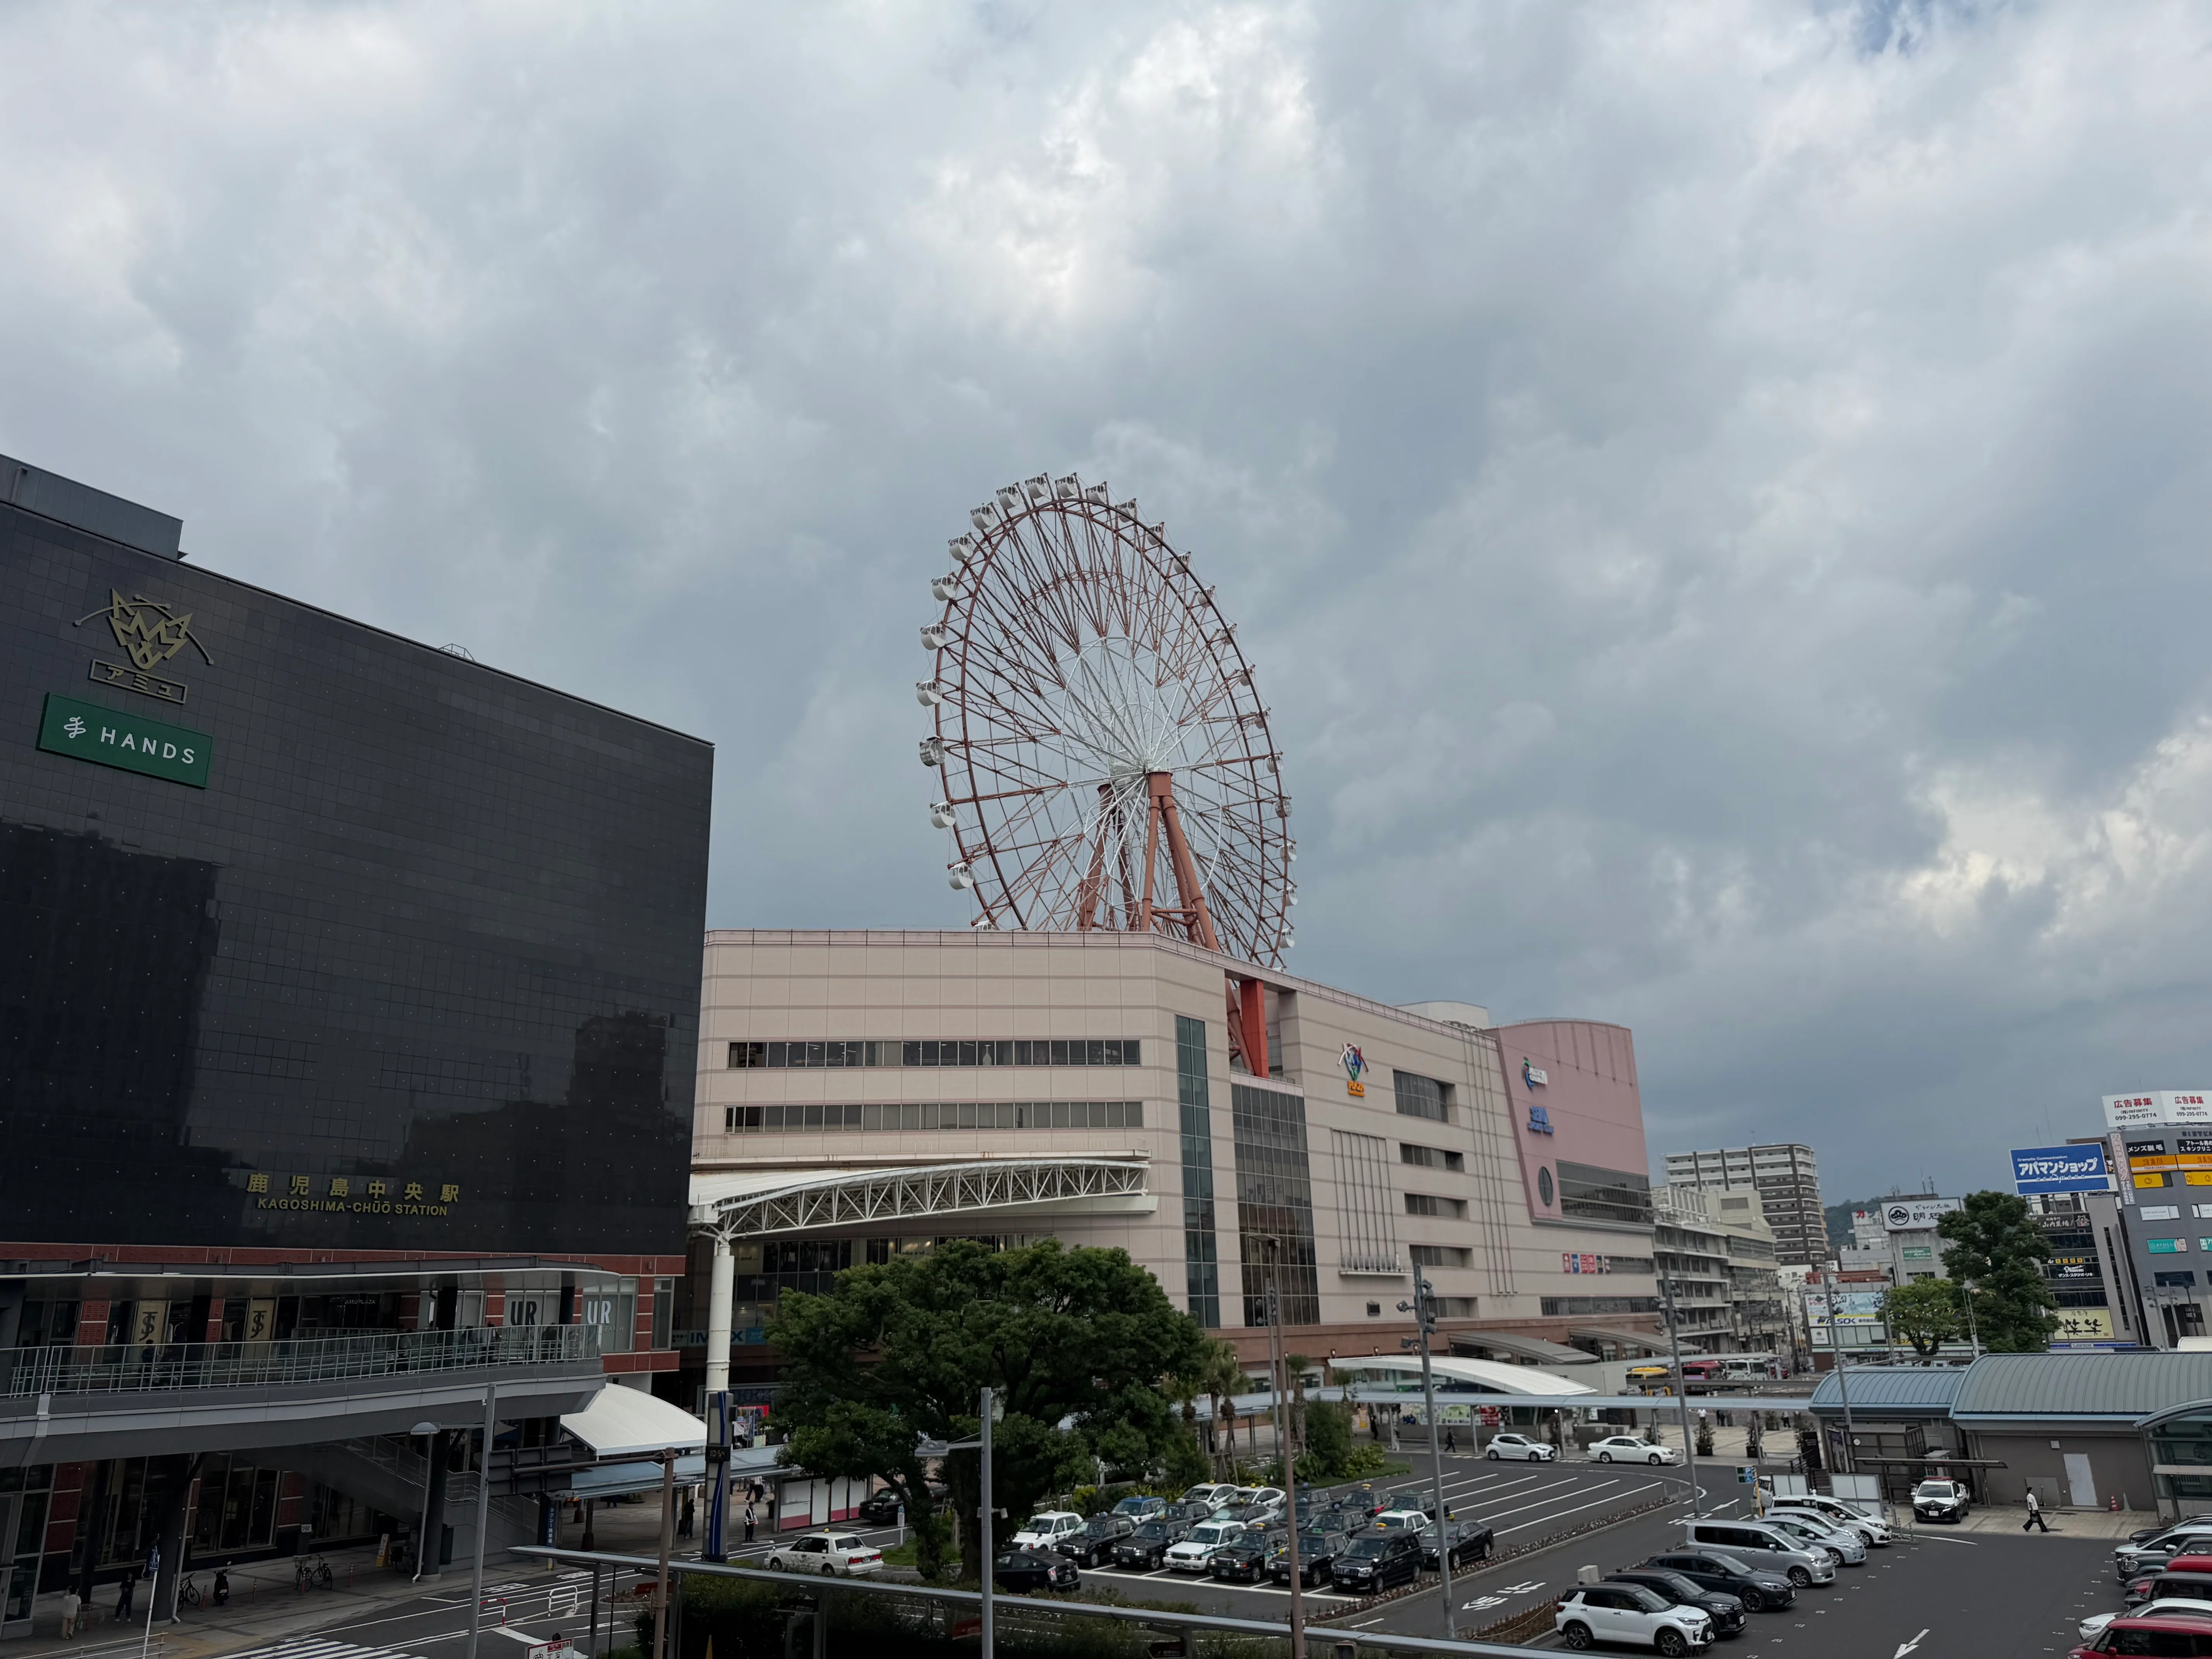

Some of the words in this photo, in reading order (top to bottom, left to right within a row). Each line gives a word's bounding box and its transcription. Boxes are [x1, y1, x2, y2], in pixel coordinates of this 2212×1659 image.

[105, 665, 173, 697] アミュ
[100, 726, 196, 765] HANDS
[2114, 1097, 2153, 1108] 広告募集
[2175, 1096, 2204, 1104] 広告募集
[2128, 1144, 2163, 1152] メンズ脱毛
[2018, 1157, 2098, 1176] アパマンショップ
[246, 1173, 460, 1203] 鹿児島中央駅
[257, 1197, 391, 1214] KAGOSHIMA-CHŪŌ
[394, 1204, 448, 1217] STATION
[510, 1300, 538, 1326] UR
[587, 1300, 611, 1324] UR
[690, 1331, 744, 1343] IMX
